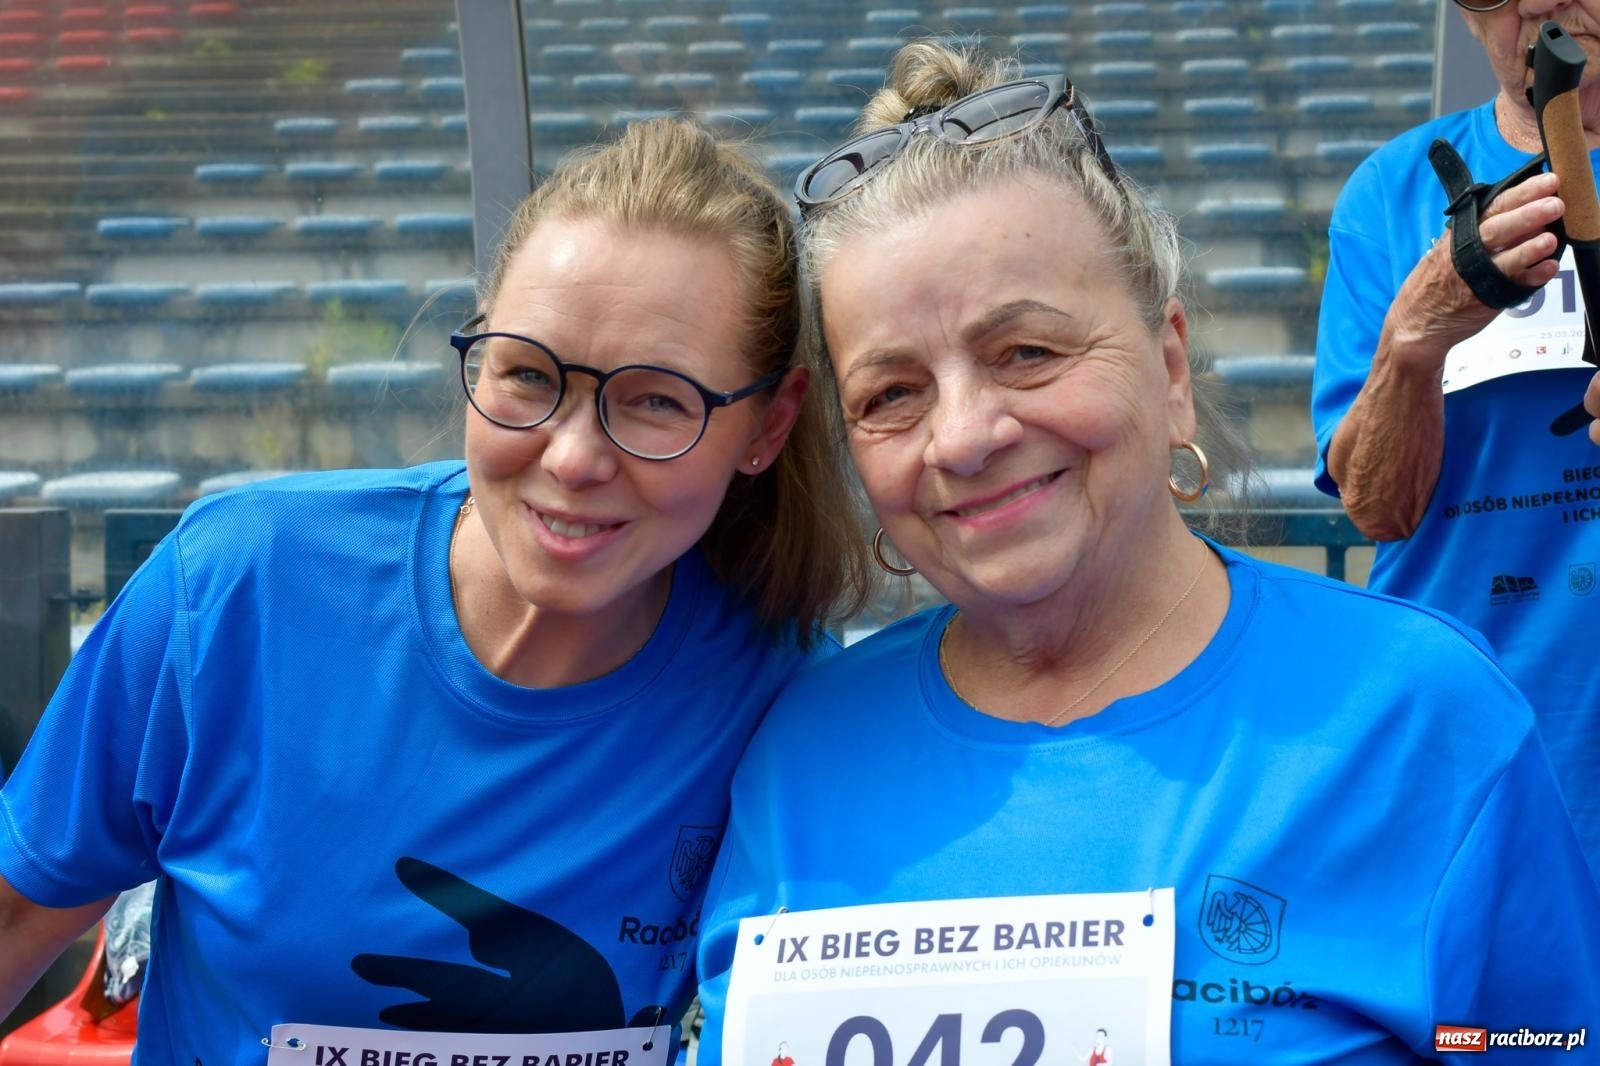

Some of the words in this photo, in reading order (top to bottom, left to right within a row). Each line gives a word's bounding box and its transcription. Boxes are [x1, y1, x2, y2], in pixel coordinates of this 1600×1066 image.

[1464, 495, 1508, 514] OSÓB
[1562, 510, 1569, 523] I
[1573, 508, 1600, 522] ICH
[776, 935, 810, 964] IX
[820, 929, 900, 961] BIEG
[914, 925, 981, 955] BEZ
[993, 919, 1126, 951] BARIER
[774, 970, 798, 983] DLA
[800, 963, 837, 981] OSÓB
[840, 959, 992, 977] NIEPEŁNOSPRAWNYCH
[1002, 957, 1027, 971] ICH
[1029, 952, 1123, 969] OPIEKUNÓW
[825, 1008, 1046, 1066] 042
[1212, 1016, 1265, 1043] 1217
[315, 1045, 350, 1066] IX
[360, 1048, 438, 1066] BIEG
